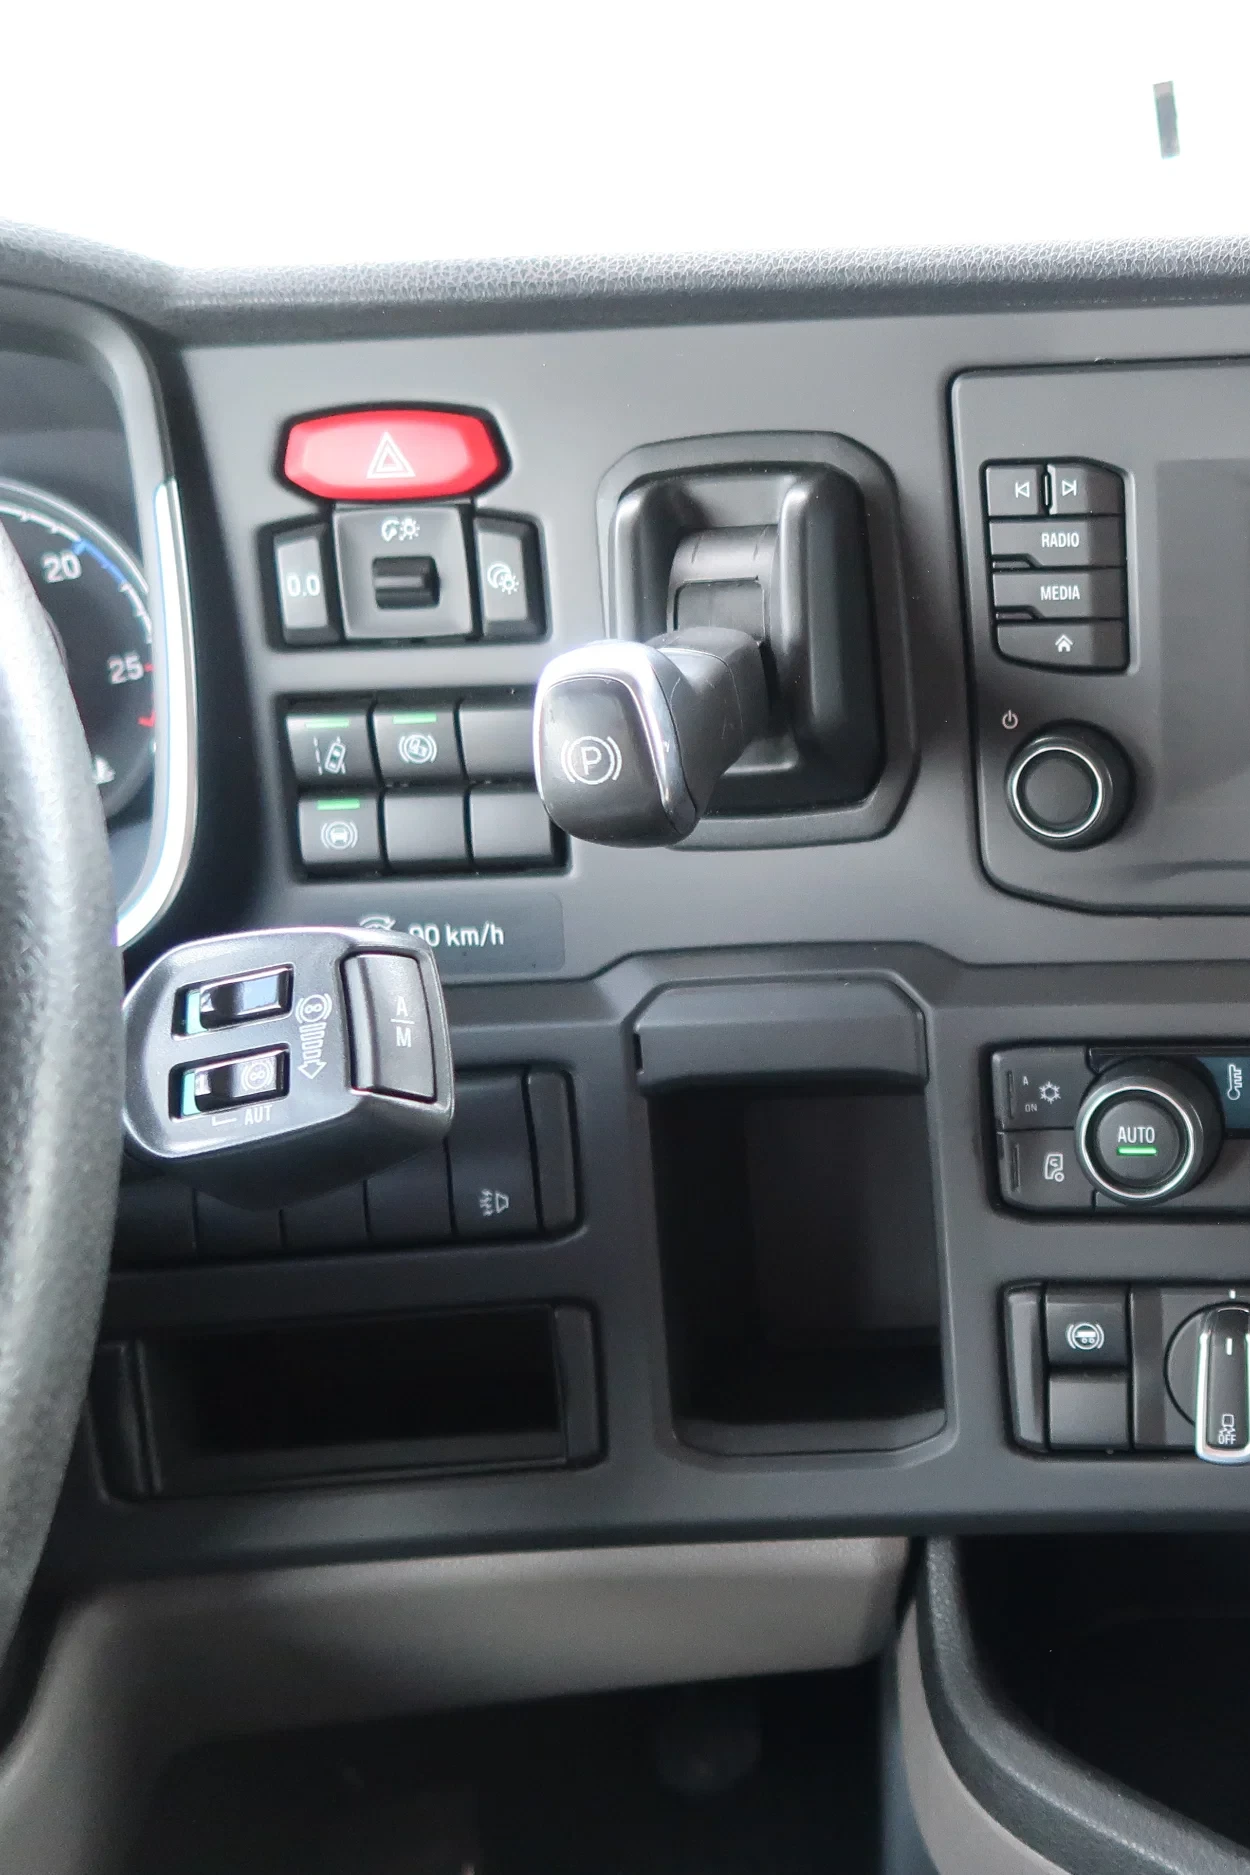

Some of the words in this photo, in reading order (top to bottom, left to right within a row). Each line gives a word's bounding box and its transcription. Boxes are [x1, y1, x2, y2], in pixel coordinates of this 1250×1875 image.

[1041, 532, 1080, 549] RADIO
[43, 554, 82, 582] 20
[288, 574, 320, 597] 0.0
[1040, 584, 1081, 601] MEDIA
[108, 652, 143, 684] 25
[580, 746, 602, 775] P
[446, 921, 504, 947] km/h
[395, 996, 409, 1017] A
[397, 1028, 411, 1049] M
[1022, 1075, 1029, 1086] A
[244, 1106, 272, 1124] AUT
[1024, 1103, 1038, 1112] ON
[1118, 1126, 1155, 1144] AUTO
[1217, 1434, 1236, 1445] OFF
